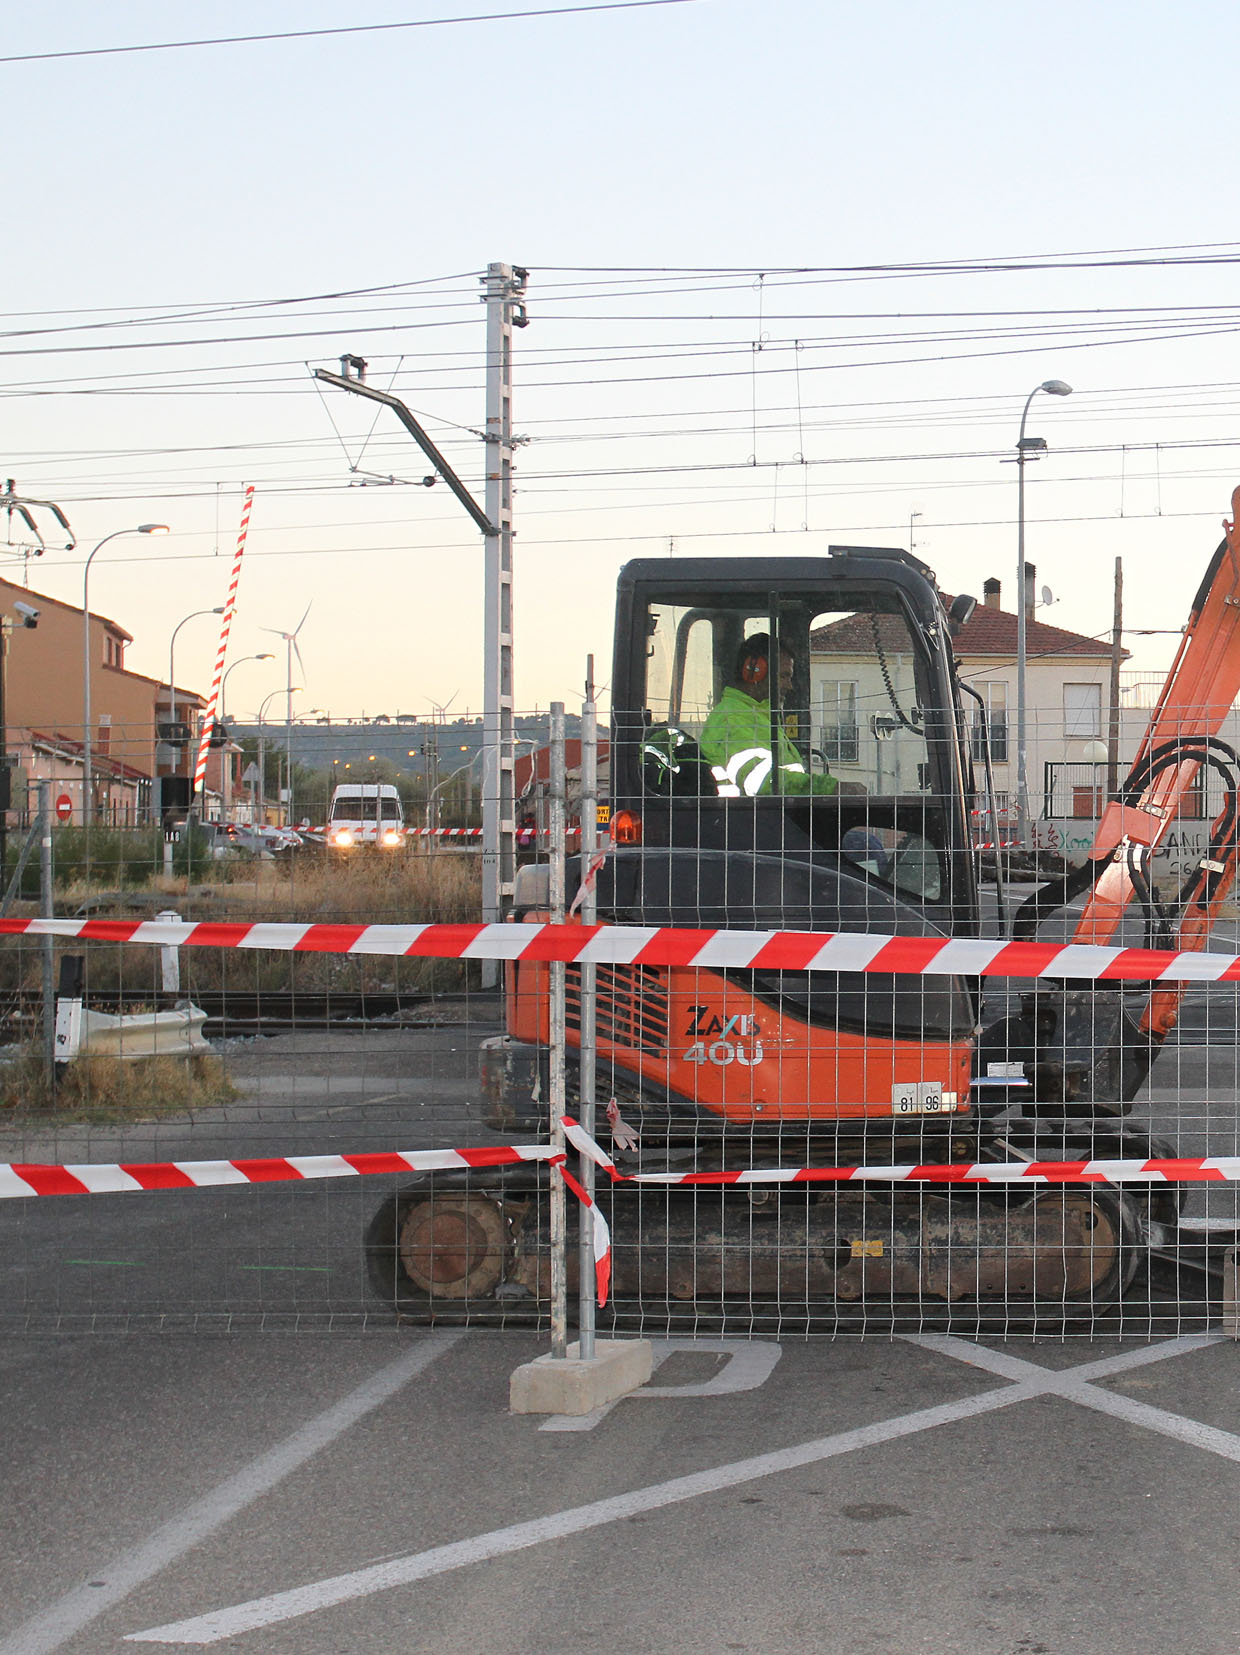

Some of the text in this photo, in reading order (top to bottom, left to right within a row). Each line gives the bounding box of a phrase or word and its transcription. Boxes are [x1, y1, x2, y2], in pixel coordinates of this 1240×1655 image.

[682, 1040, 764, 1066] 40U
[900, 1096, 914, 1113] 81
[925, 1095, 940, 1111] 96
[538, 1338, 783, 1432] P
